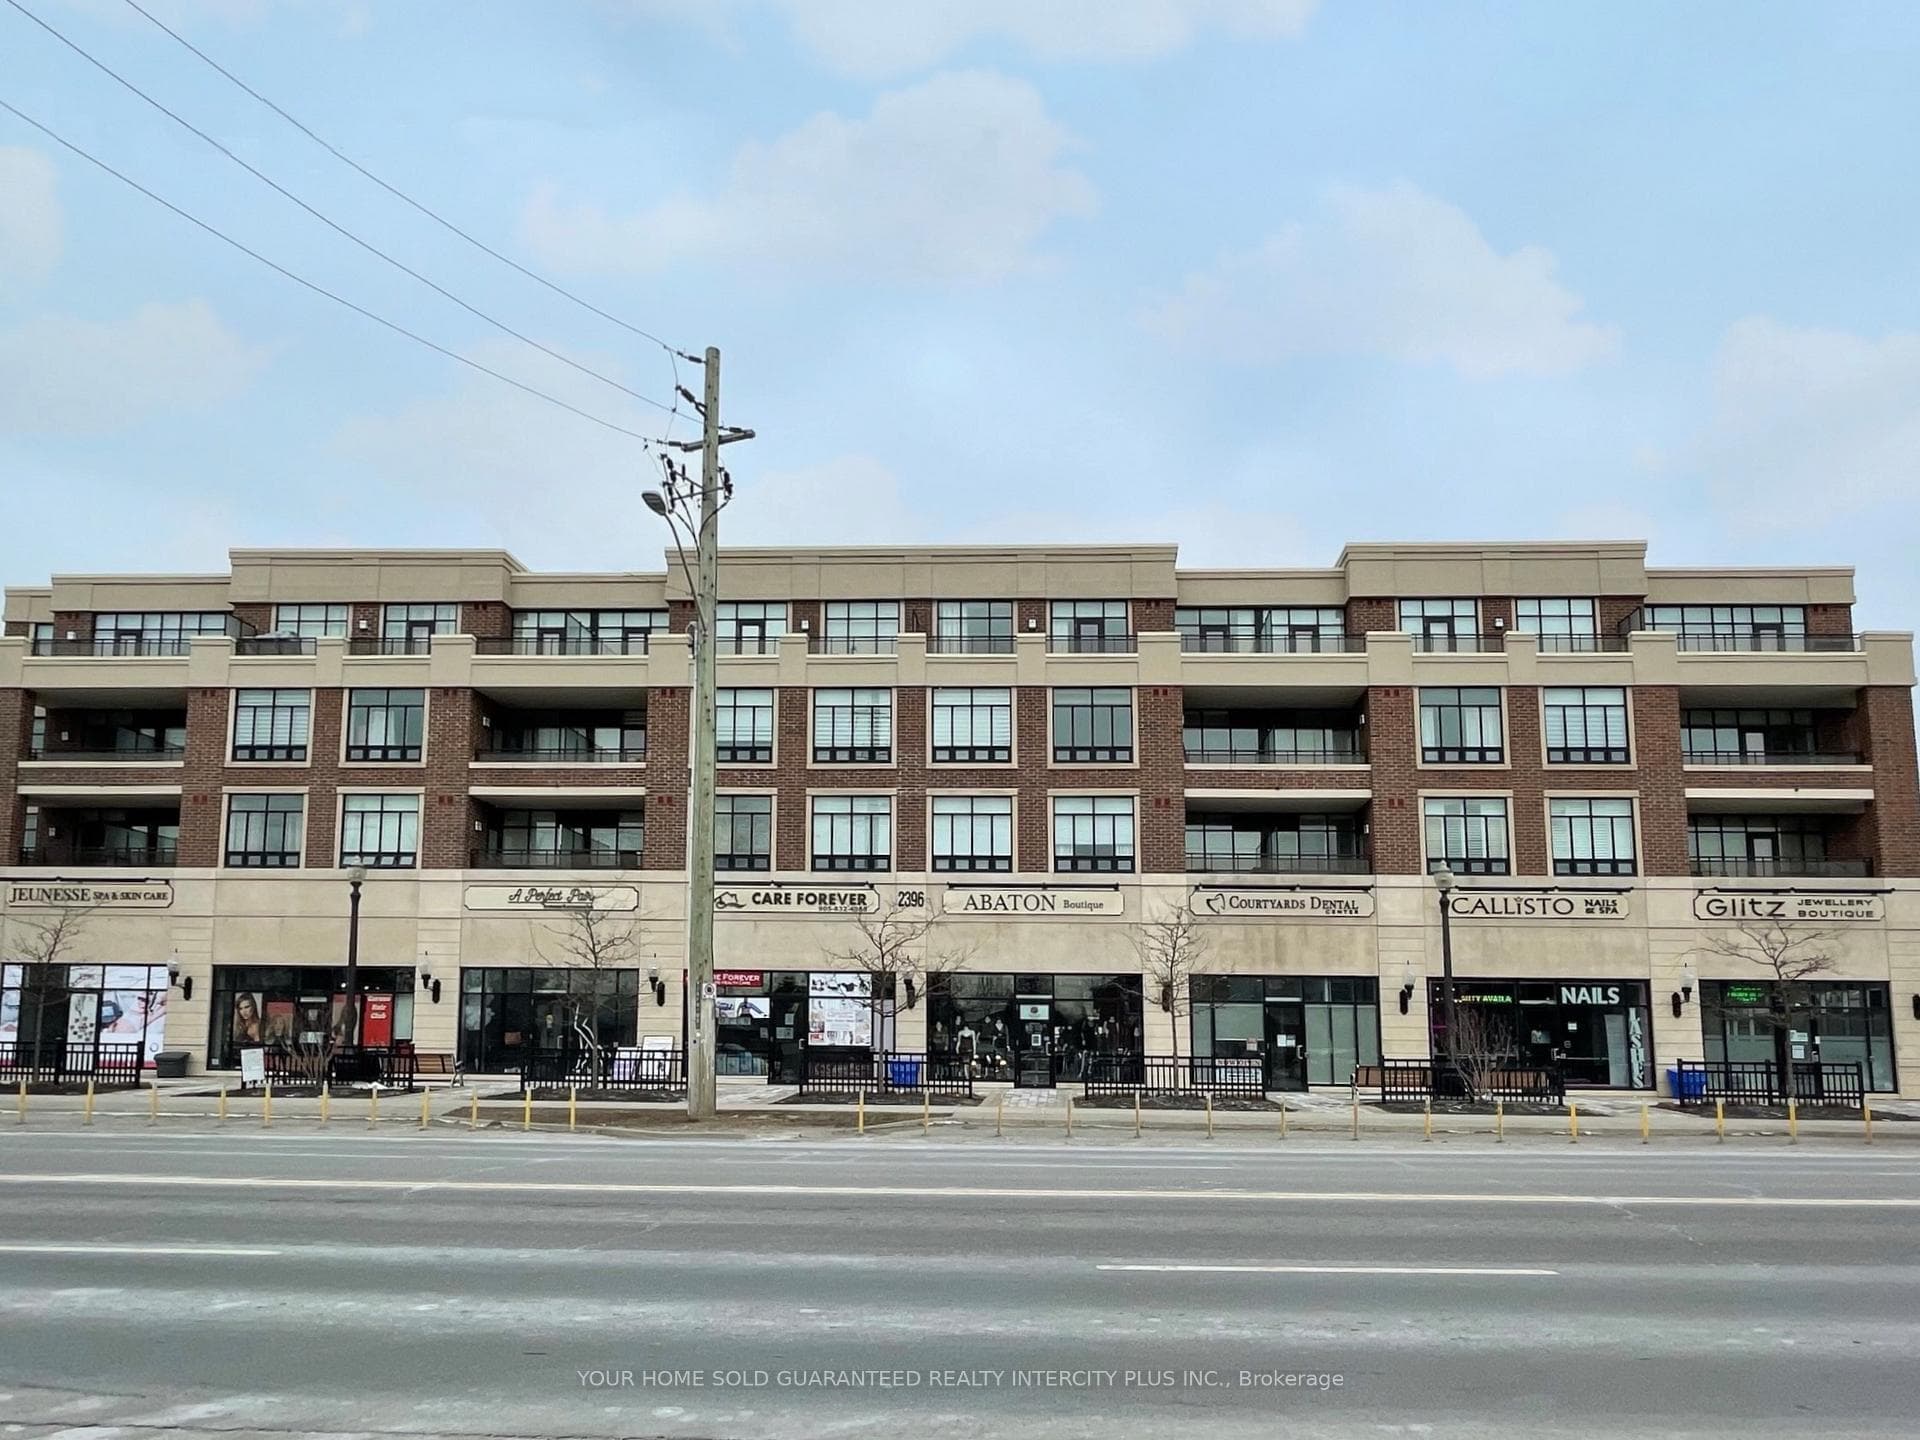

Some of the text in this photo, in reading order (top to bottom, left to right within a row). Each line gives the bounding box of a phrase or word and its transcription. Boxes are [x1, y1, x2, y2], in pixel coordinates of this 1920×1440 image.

[9, 888, 169, 903] JEUNESSE SPA & SKIN CARE
[525, 888, 563, 903] Perfect
[751, 892, 867, 906] CARE FOREVER
[898, 891, 925, 907] 2396
[963, 894, 1104, 912] ABATON Boutique
[1584, 899, 1617, 907] NAILS
[1229, 896, 1359, 911] COURTYARDS DENTAL
[1706, 898, 1786, 917] Glitz
[1797, 910, 1874, 918] BOUTIQUE
[722, 973, 761, 981] FOREVER
[1561, 986, 1620, 1005] NAILS
